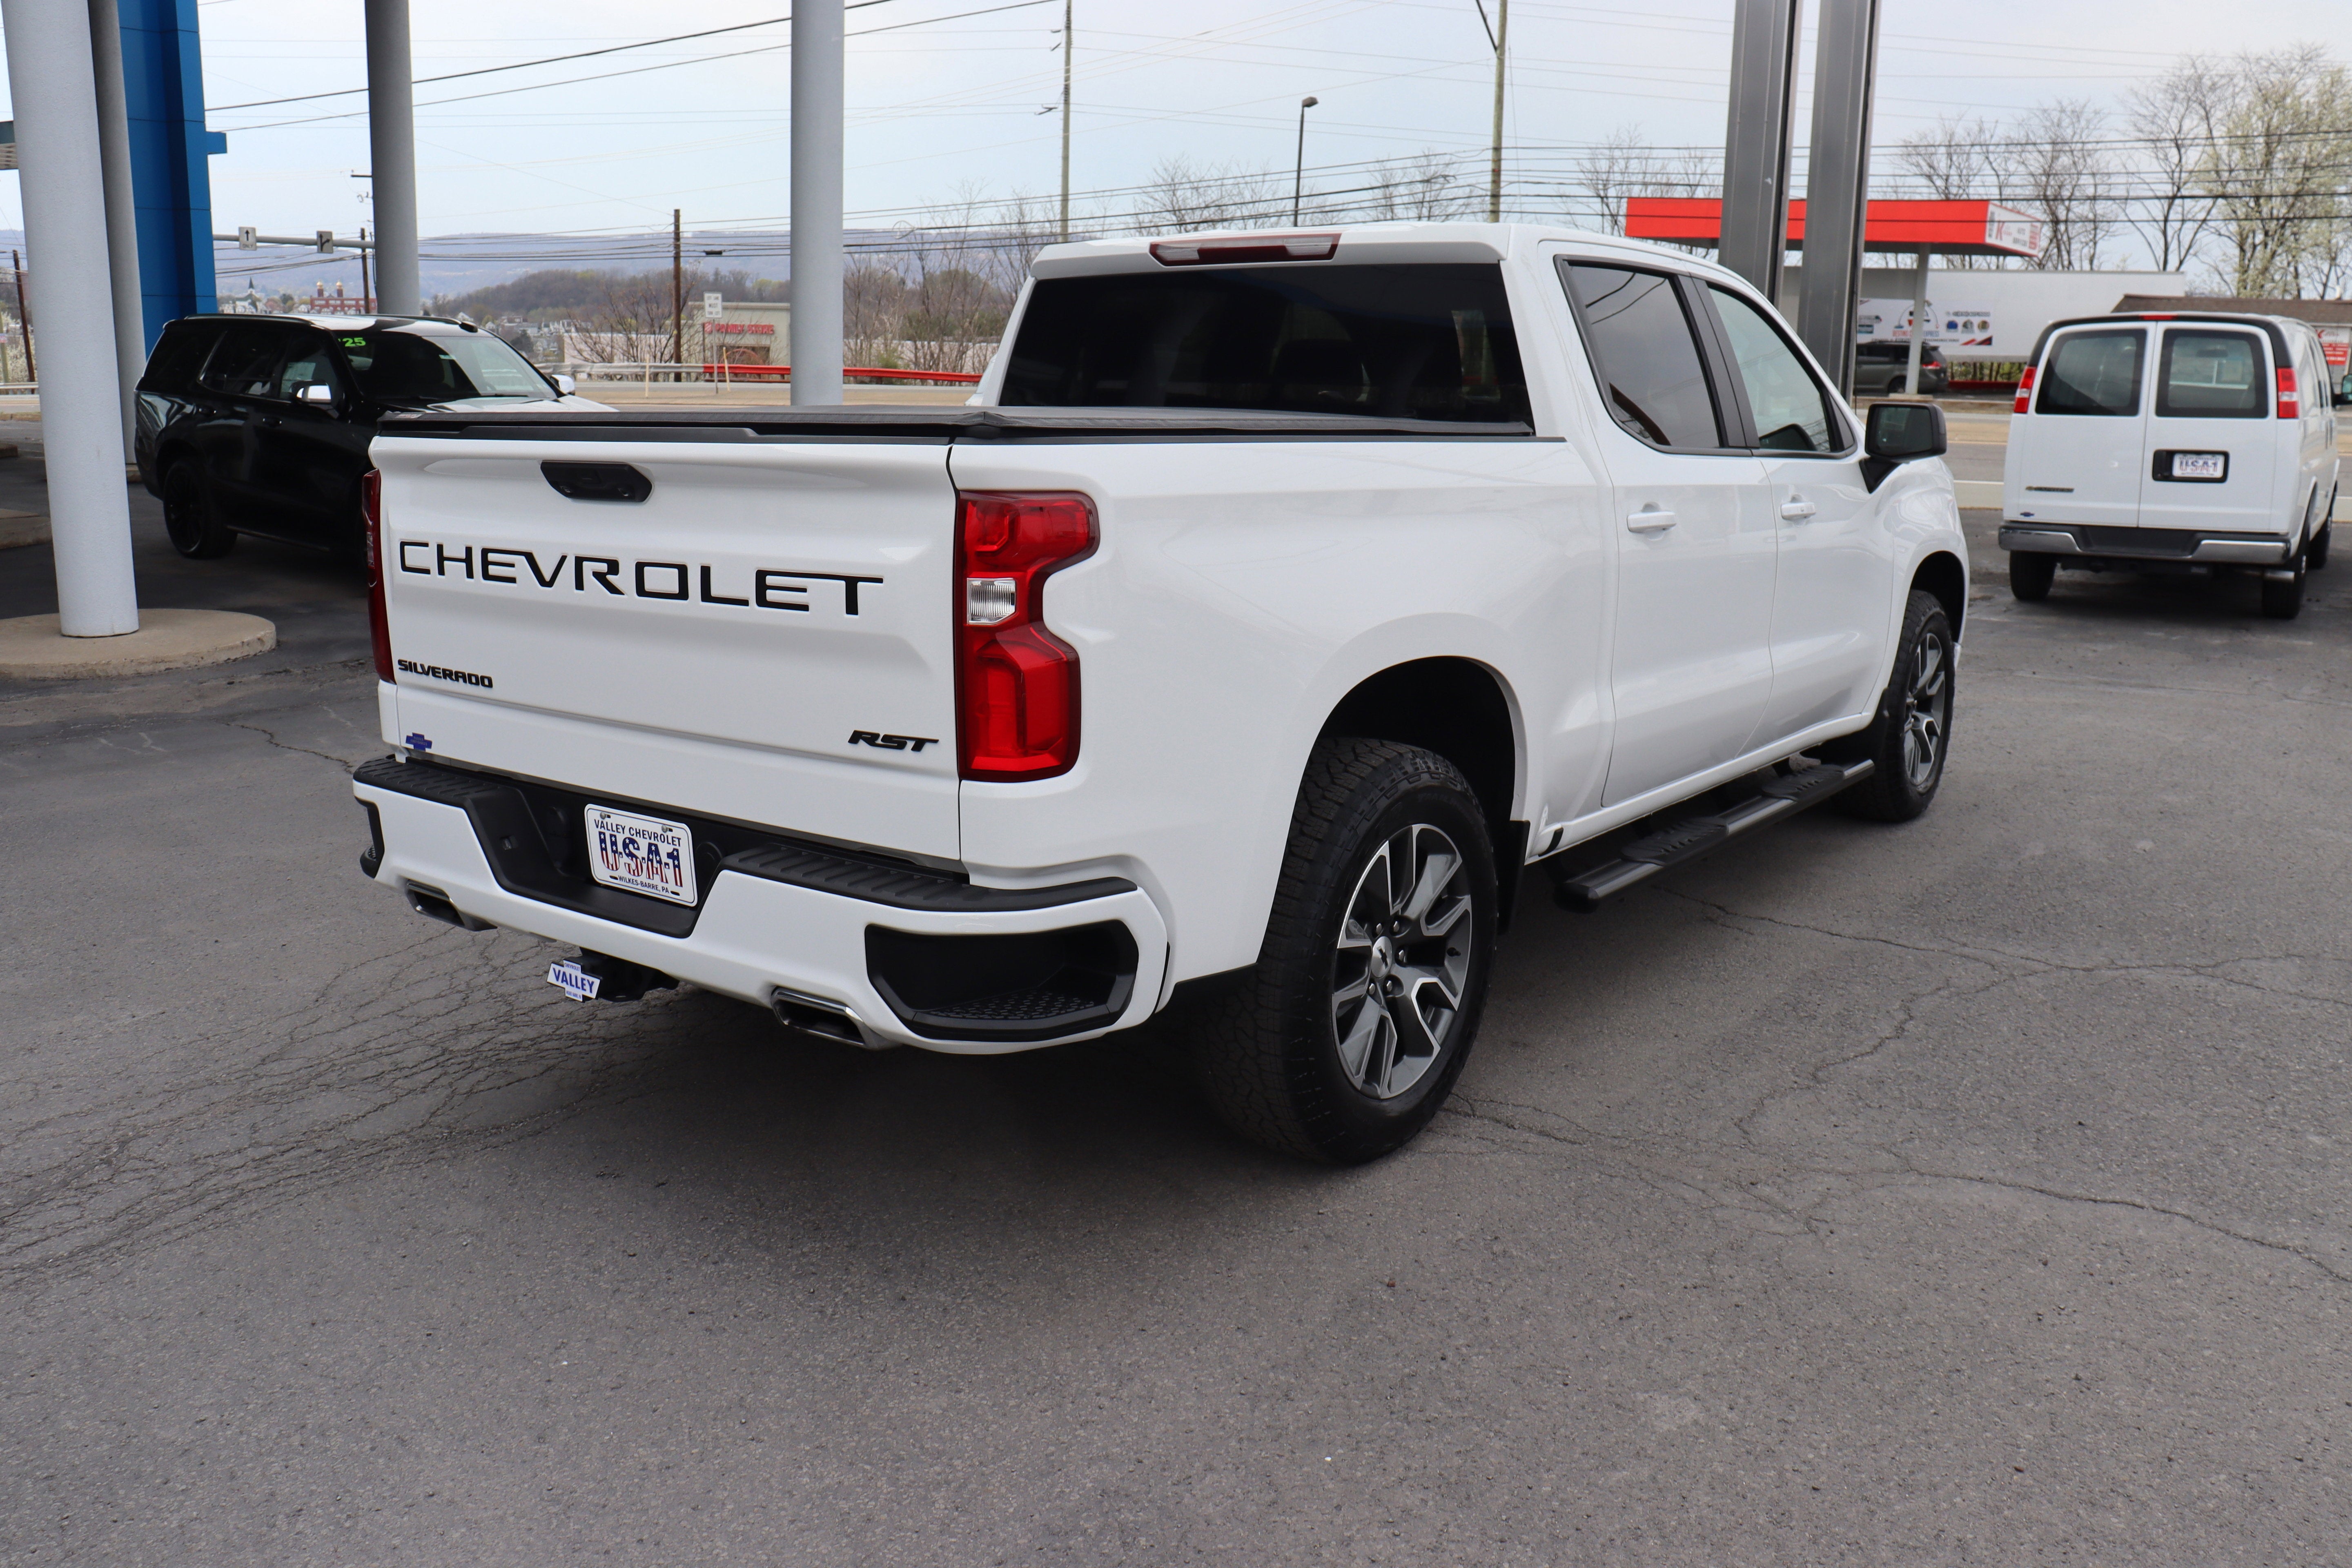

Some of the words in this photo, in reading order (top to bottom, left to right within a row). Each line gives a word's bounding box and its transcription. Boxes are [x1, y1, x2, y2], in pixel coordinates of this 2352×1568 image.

[715, 323, 745, 333] FAMILY
[746, 324, 774, 334] STORE
[400, 541, 884, 616] CHEVROLET
[398, 659, 493, 688] SILVERADO
[848, 730, 939, 752] RST
[594, 819, 626, 834] VALLEY
[629, 826, 681, 847] CHEVROLET
[618, 875, 661, 892] WILKES-BARRE,
[564, 962, 580, 971] CHEVROLET
[553, 967, 595, 993] VALLEY
